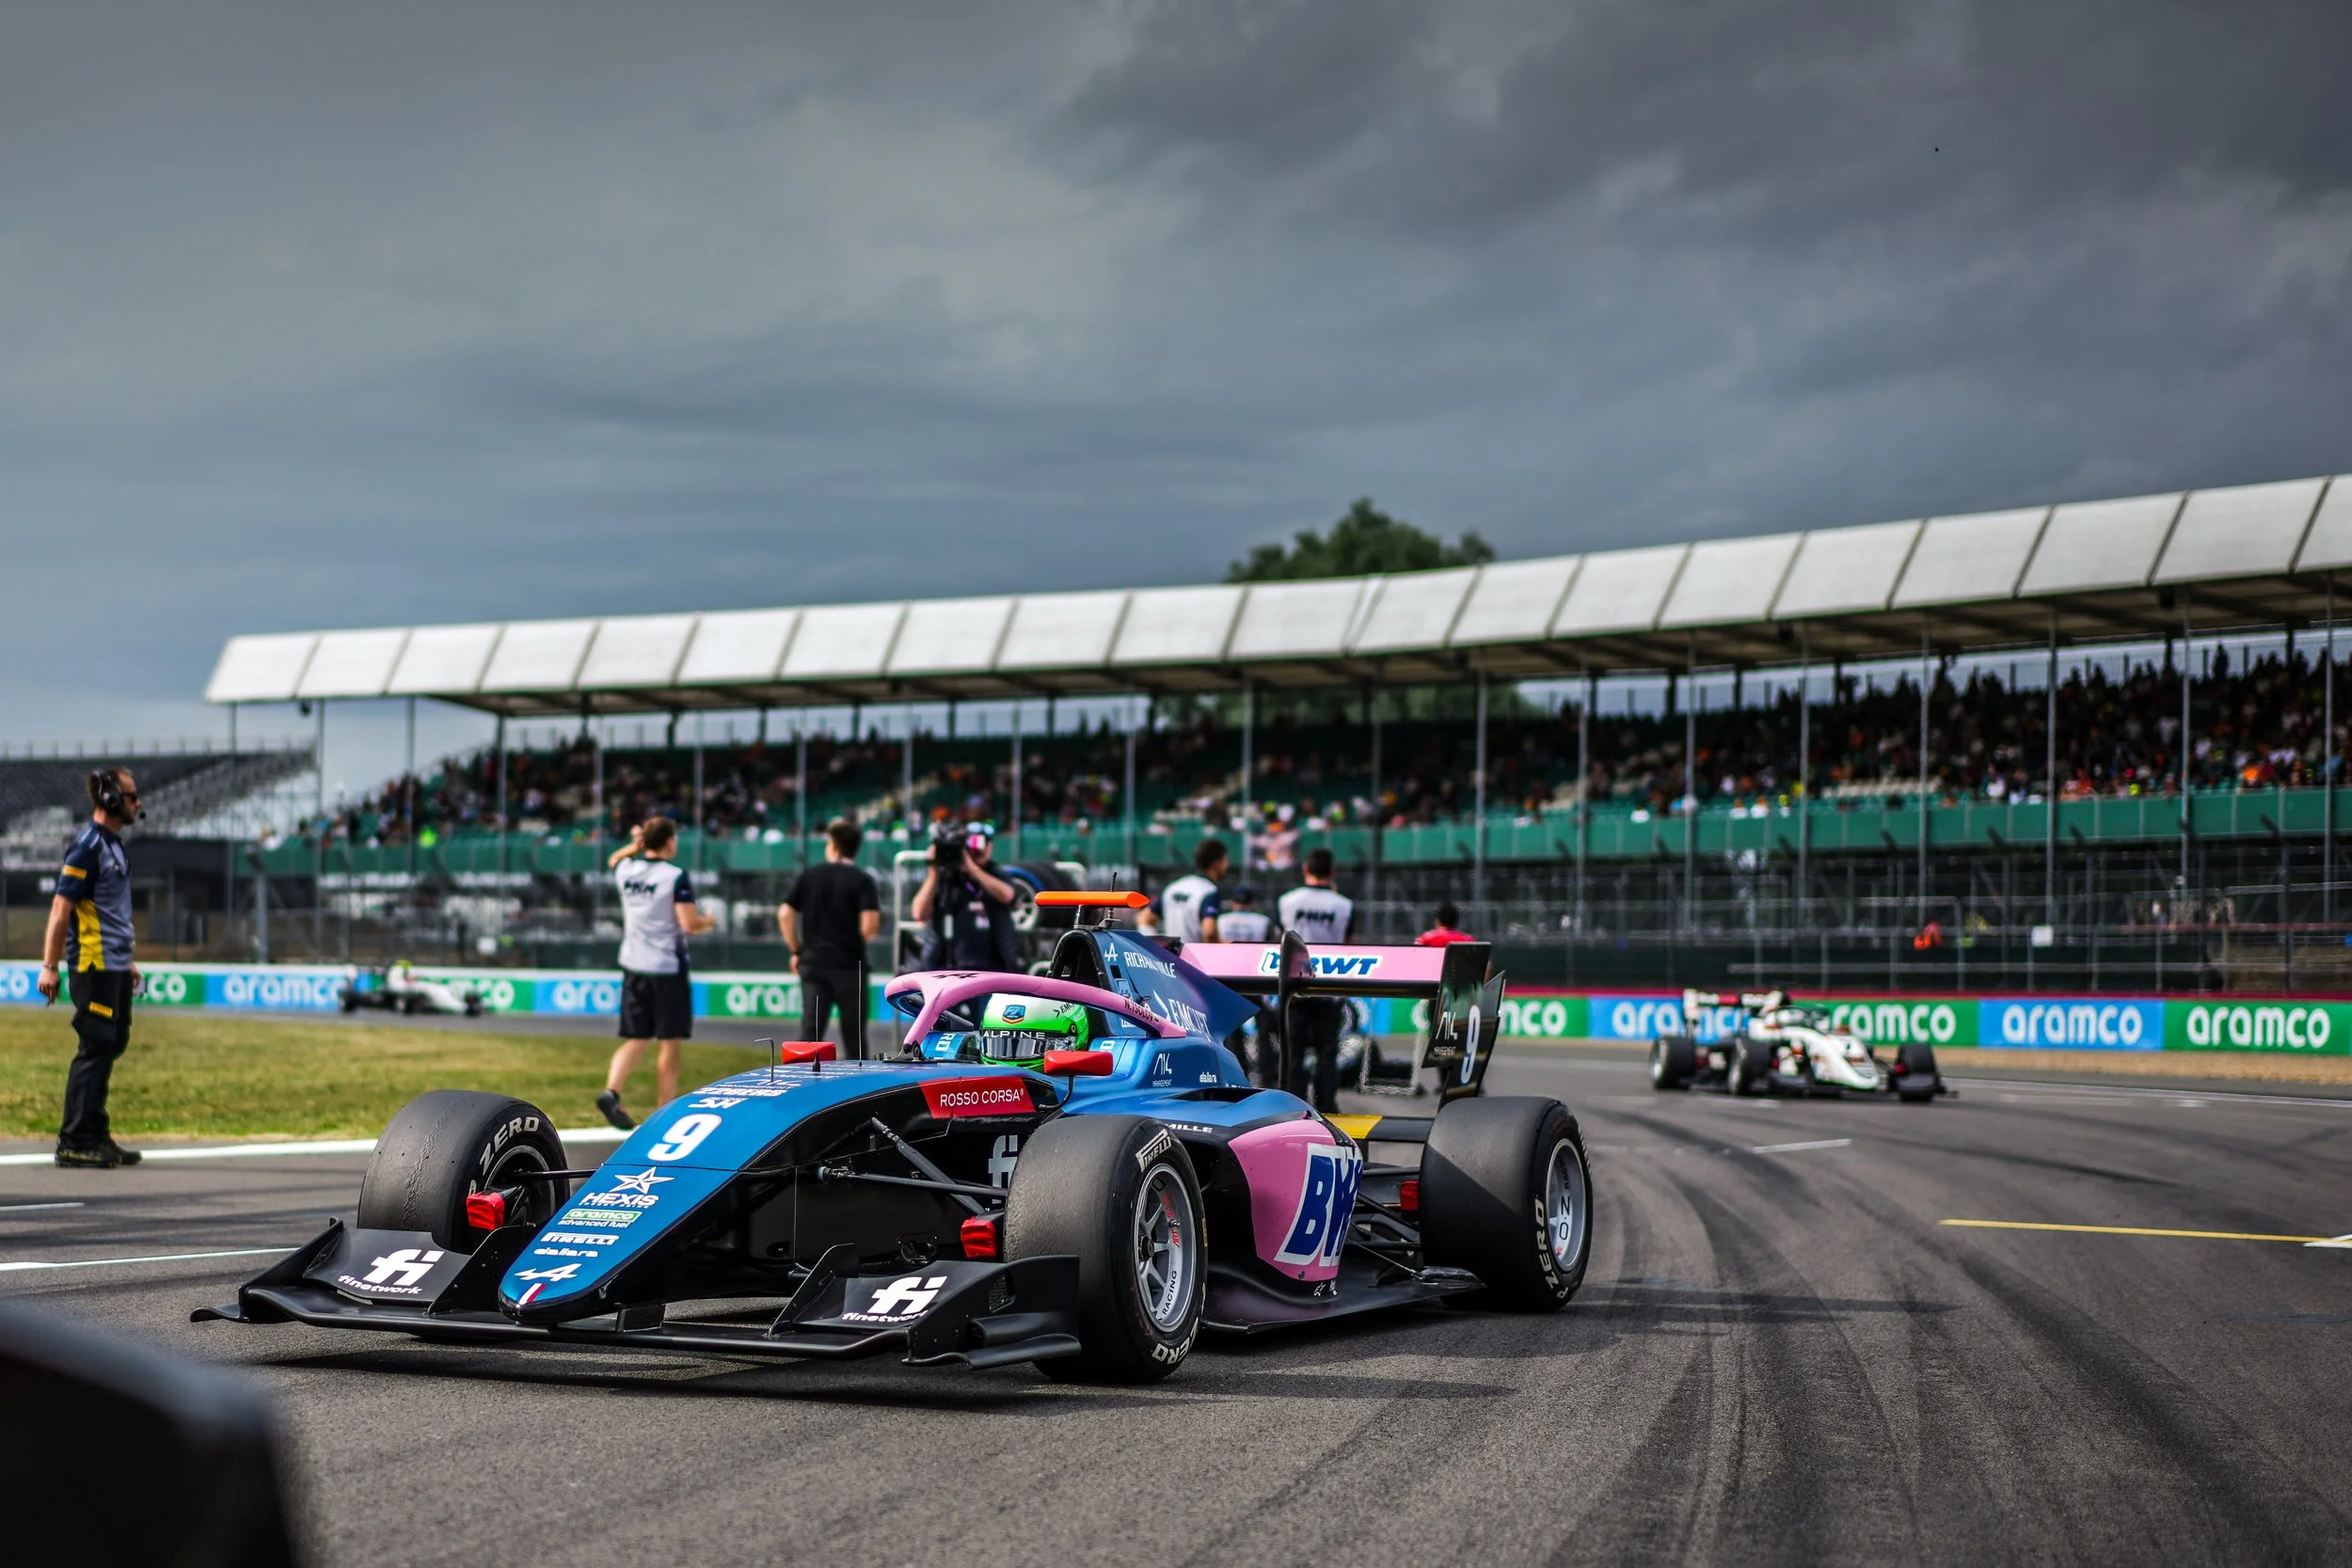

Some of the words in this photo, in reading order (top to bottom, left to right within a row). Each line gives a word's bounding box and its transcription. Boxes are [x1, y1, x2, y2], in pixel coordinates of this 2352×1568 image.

[1833, 1004, 1956, 1042] ramco
[2002, 1004, 2142, 1045] aramco
[2186, 1005, 2330, 1049] aramco
[982, 1030, 1046, 1039] ALPINE
[1460, 1005, 1481, 1084] 9
[1200, 1071, 1217, 1083] dallara
[940, 1092, 979, 1107] ROSSO
[1166, 1123, 1214, 1133] MILLE
[479, 1117, 540, 1176] ZERO
[646, 1114, 723, 1162] 9
[1135, 1128, 1172, 1174] PIRELLI
[579, 1192, 660, 1207] HEXIS
[557, 1219, 609, 1227] advanced
[570, 1211, 634, 1220] aramco
[540, 1231, 620, 1245] PIRELLI
[533, 1247, 598, 1258] dallara
[362, 1248, 445, 1286] fi
[338, 1275, 422, 1294] finetwork
[1161, 1270, 1178, 1316] RACING
[866, 1275, 947, 1315] fi
[842, 1309, 930, 1323] finetwor
